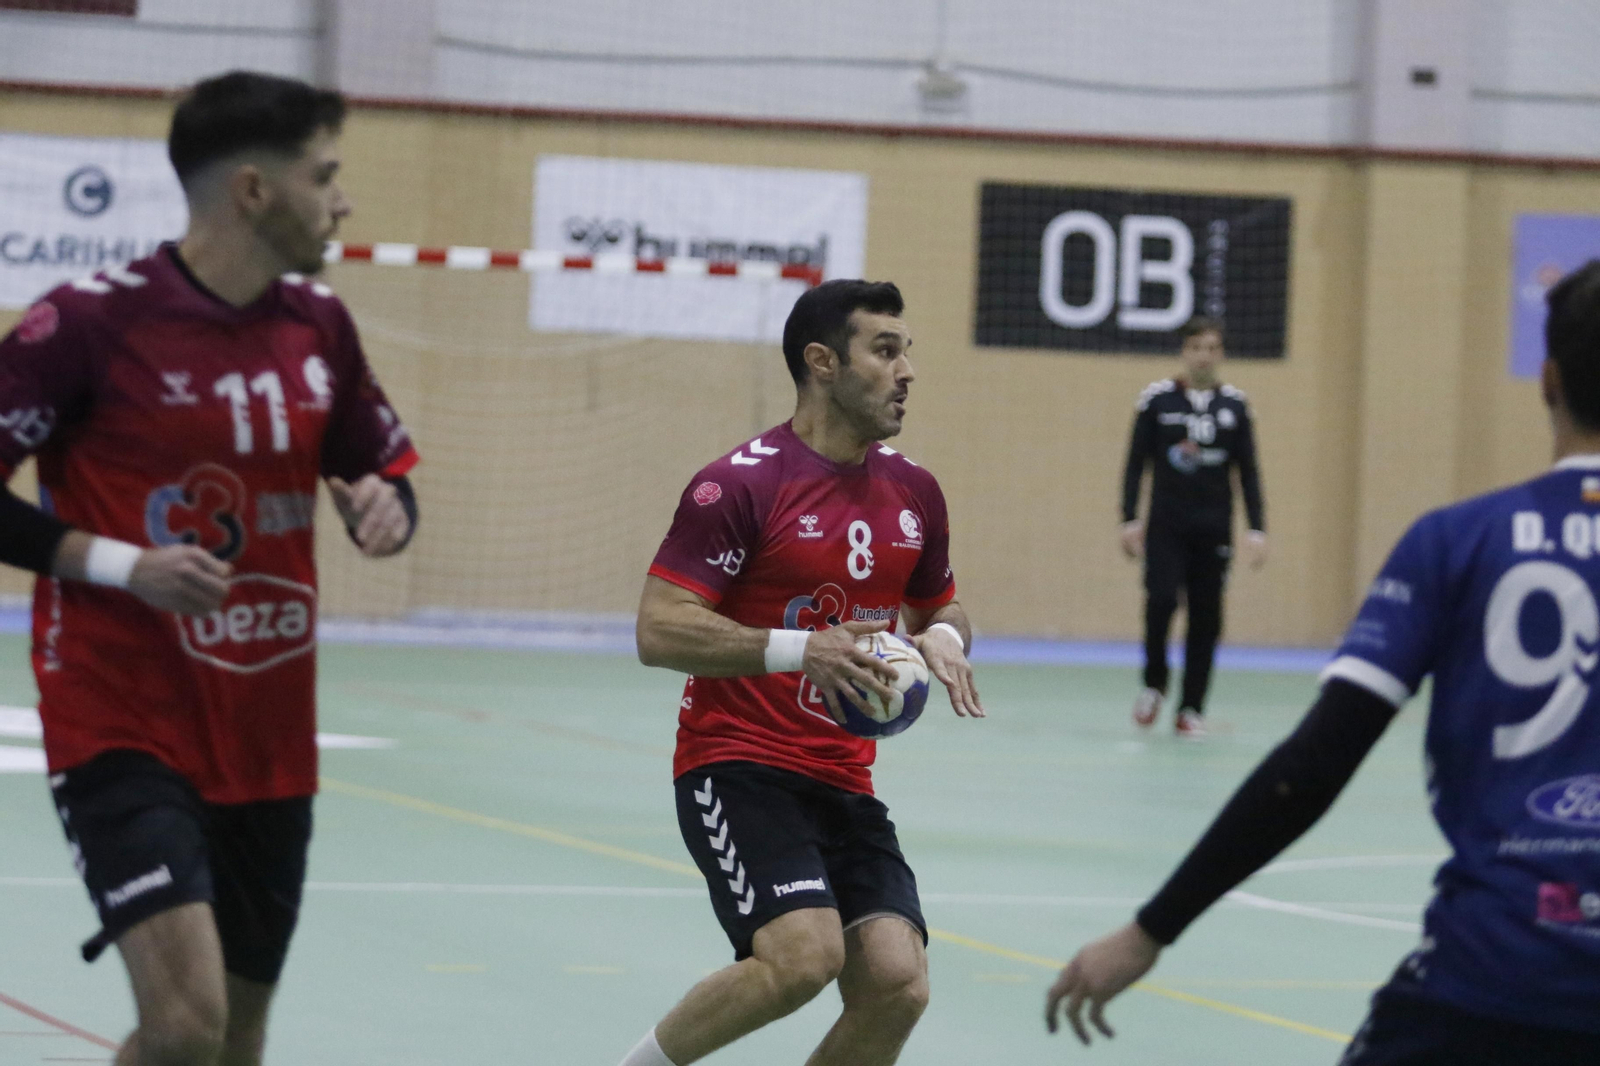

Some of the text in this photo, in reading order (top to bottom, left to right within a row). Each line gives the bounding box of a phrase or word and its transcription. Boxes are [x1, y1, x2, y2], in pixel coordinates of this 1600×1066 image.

[1040, 209, 1195, 331] OB
[213, 371, 290, 453] 11
[798, 530, 824, 538] hummel
[847, 520, 875, 580] 8
[1484, 560, 1599, 760] 9
[773, 877, 826, 897] hummel
